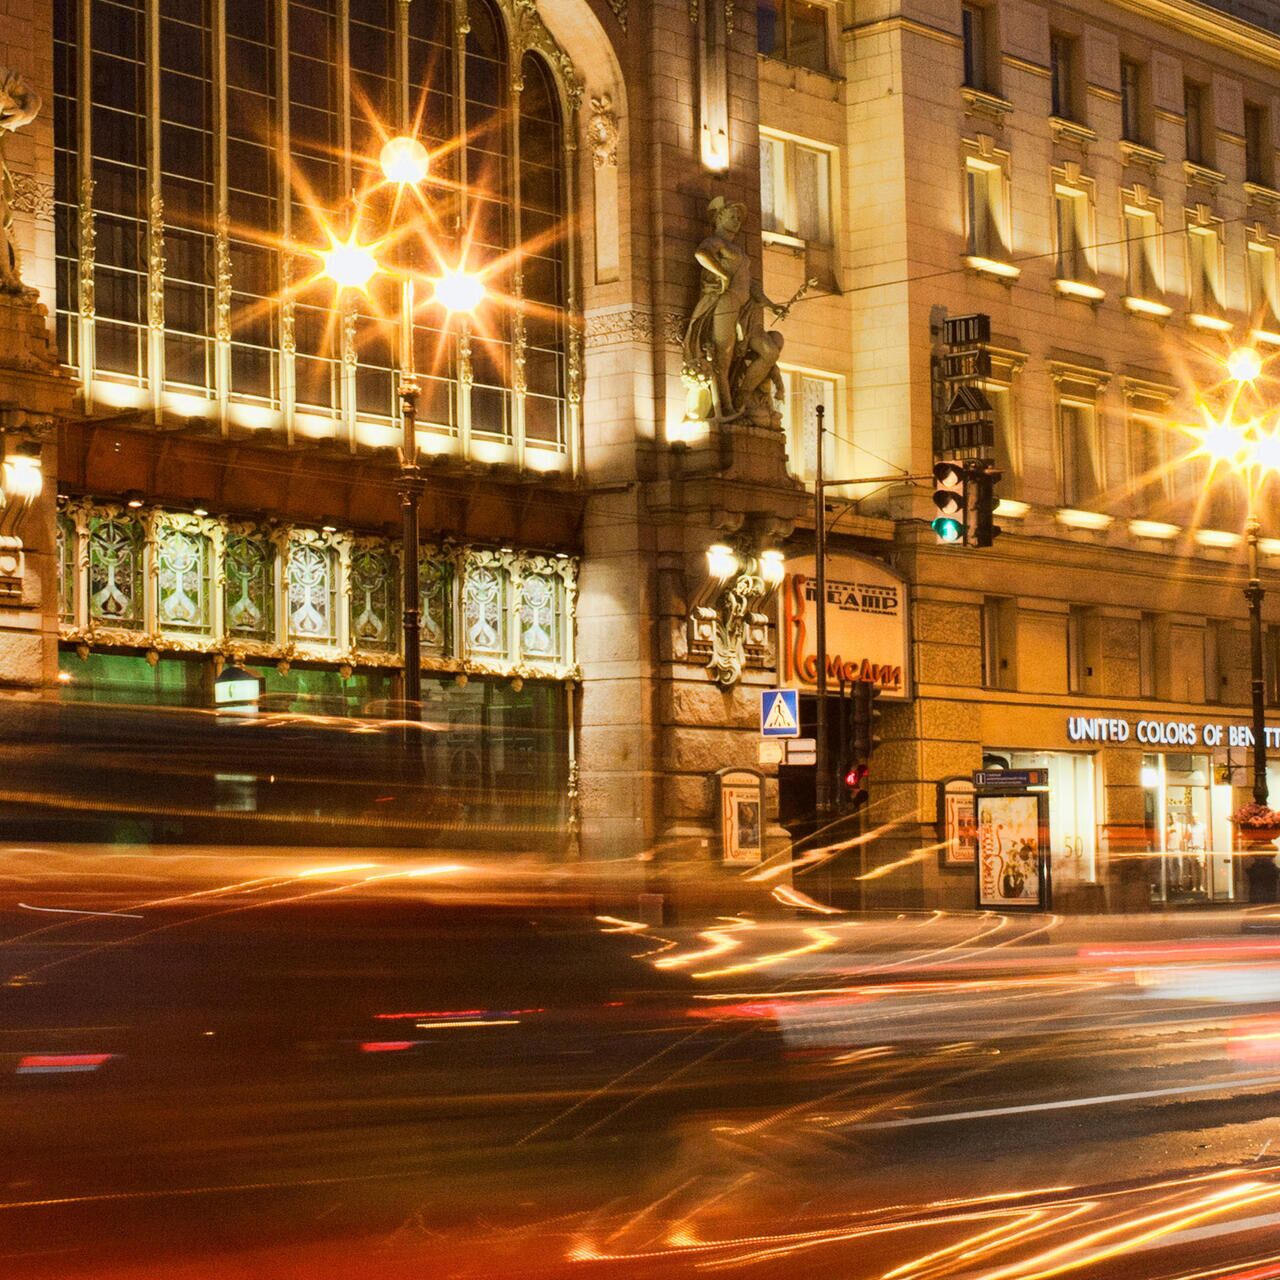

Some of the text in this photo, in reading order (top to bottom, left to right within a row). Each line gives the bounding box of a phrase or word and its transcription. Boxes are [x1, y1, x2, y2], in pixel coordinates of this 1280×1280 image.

[1068, 717, 1130, 742] UNITED
[1136, 720, 1197, 746] COLORS
[1202, 724, 1223, 747] OF
